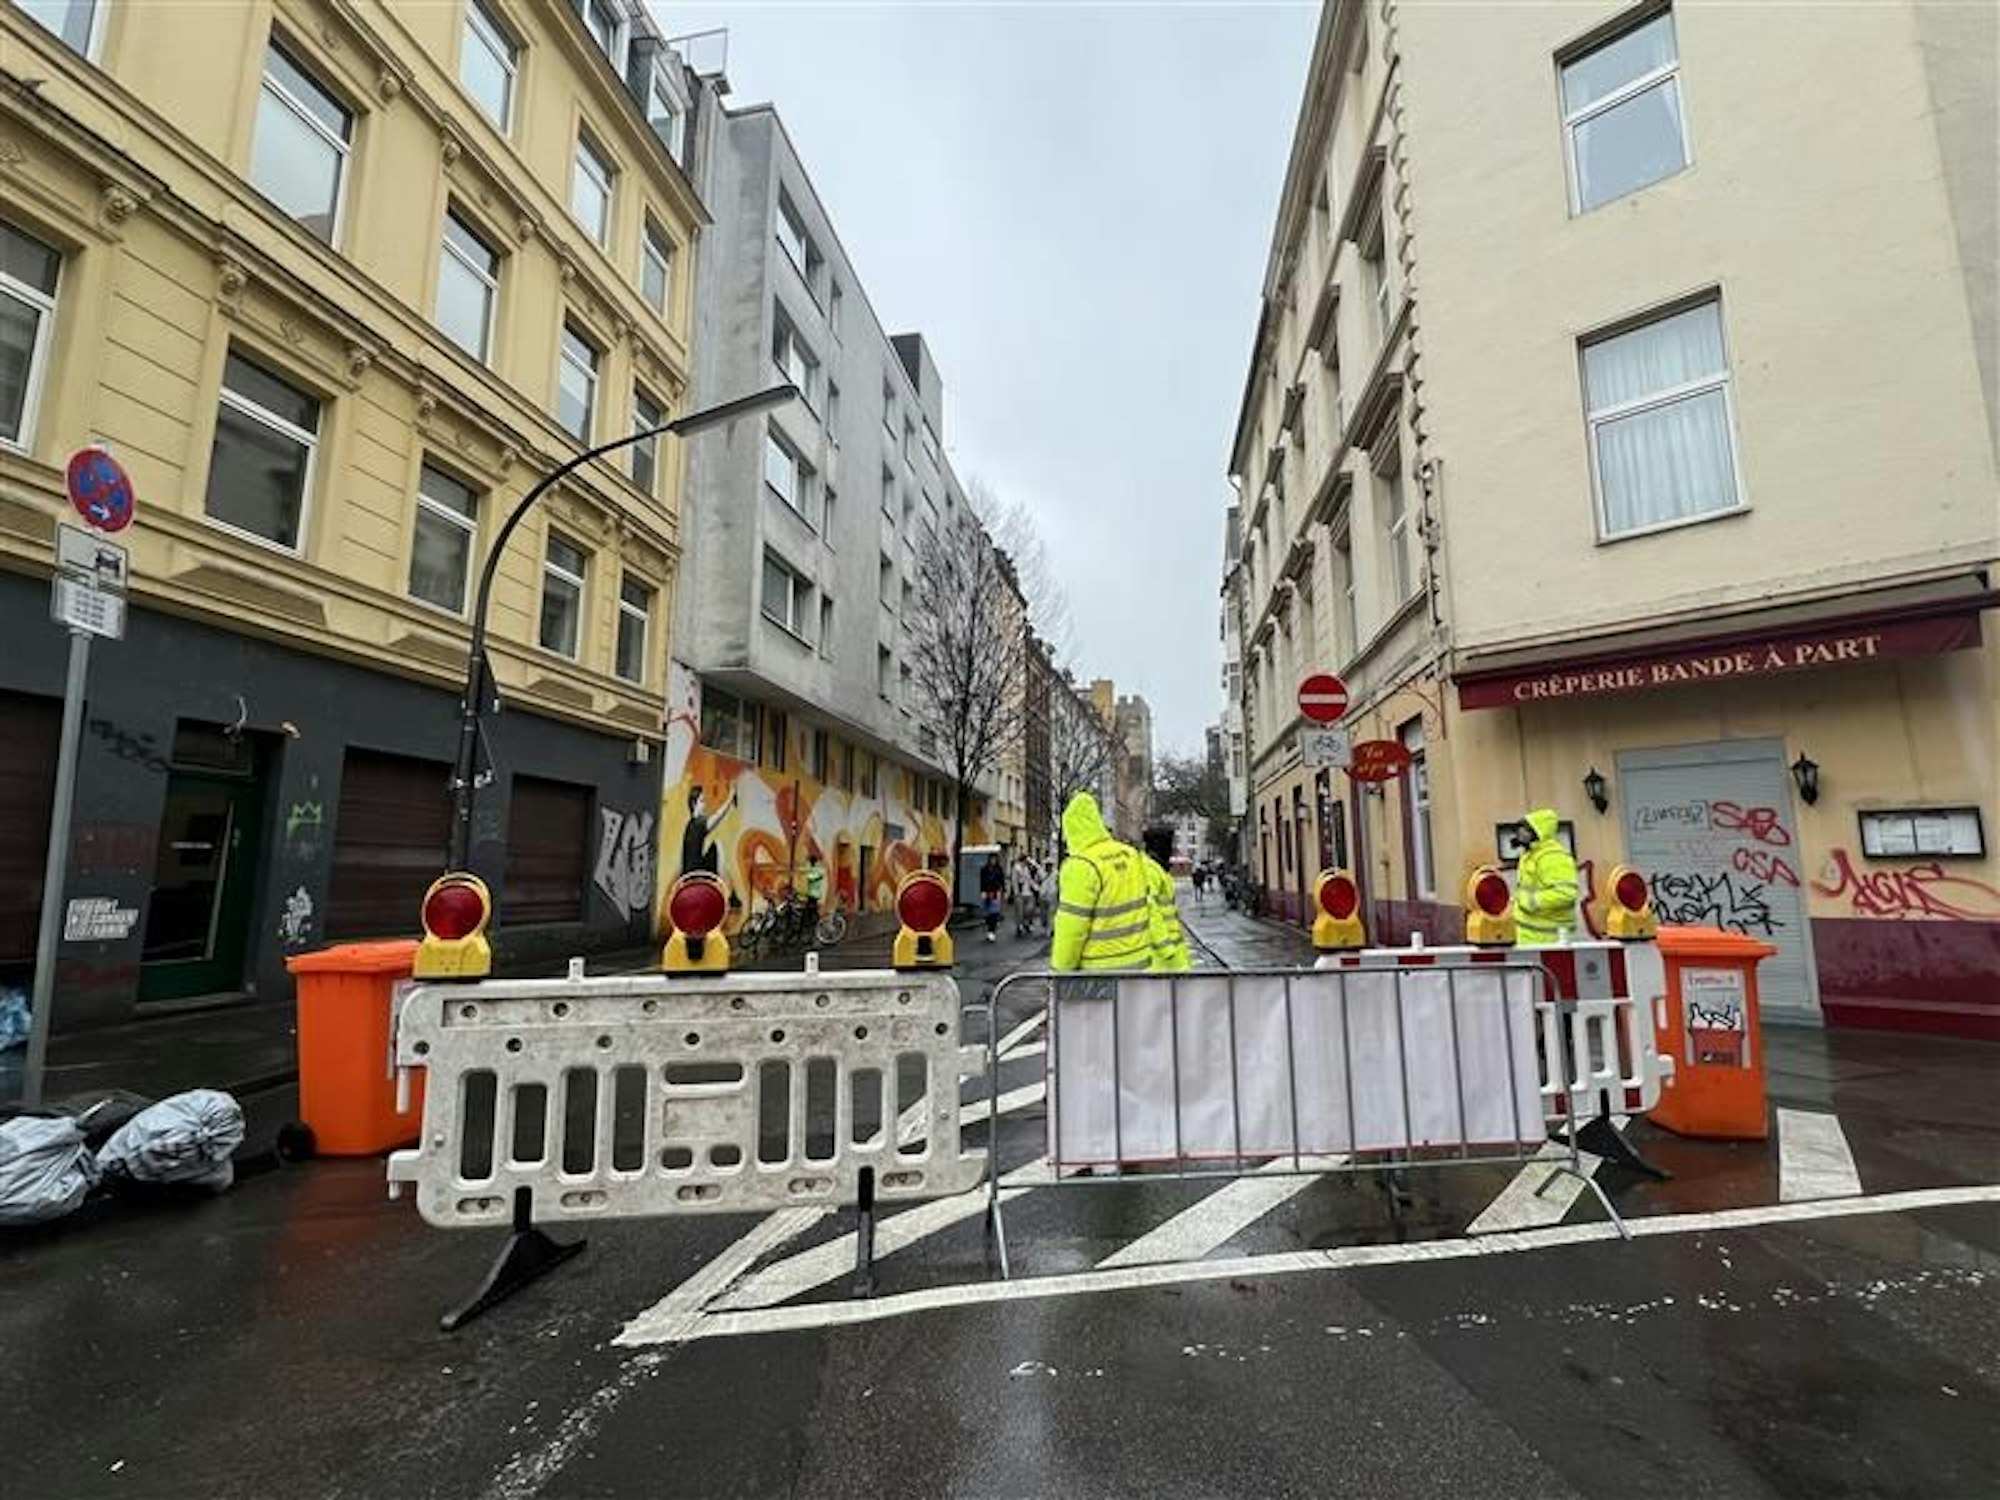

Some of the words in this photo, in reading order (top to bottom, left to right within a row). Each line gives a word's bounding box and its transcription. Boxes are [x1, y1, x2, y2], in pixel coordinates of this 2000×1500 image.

[1514, 669, 1644, 699] CRÊPERIE
[1651, 654, 1754, 683] BANDE
[1763, 645, 1785, 669] À
[1795, 635, 1881, 663] PART
